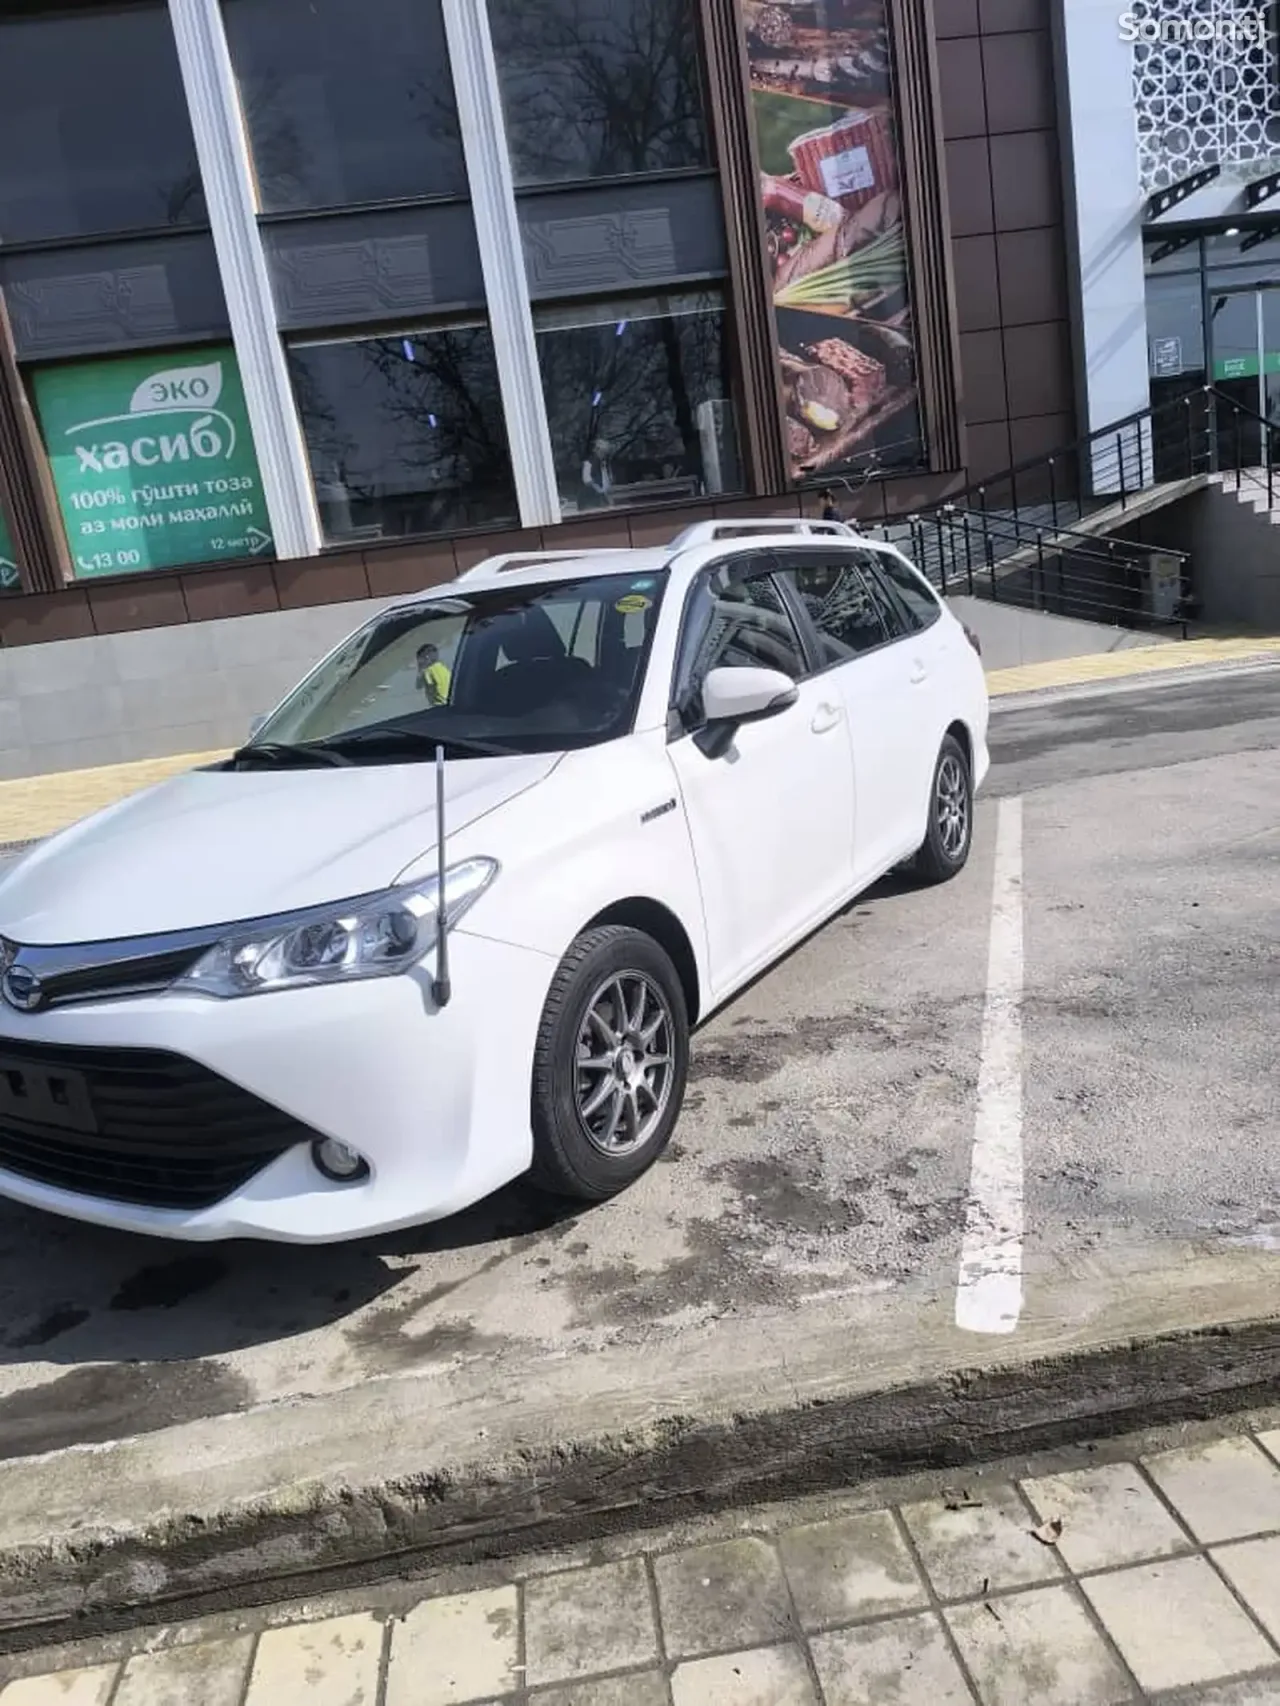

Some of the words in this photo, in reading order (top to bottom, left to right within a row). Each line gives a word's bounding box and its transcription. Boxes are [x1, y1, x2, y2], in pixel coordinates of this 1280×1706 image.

[75, 414, 222, 473] хасиб
[70, 487, 126, 510] 100%
[203, 476, 253, 494] тоза
[80, 519, 106, 535] аз
[111, 512, 164, 531] моли
[211, 537, 225, 549] 12
[93, 552, 113, 568] 13
[117, 549, 140, 566] 00
